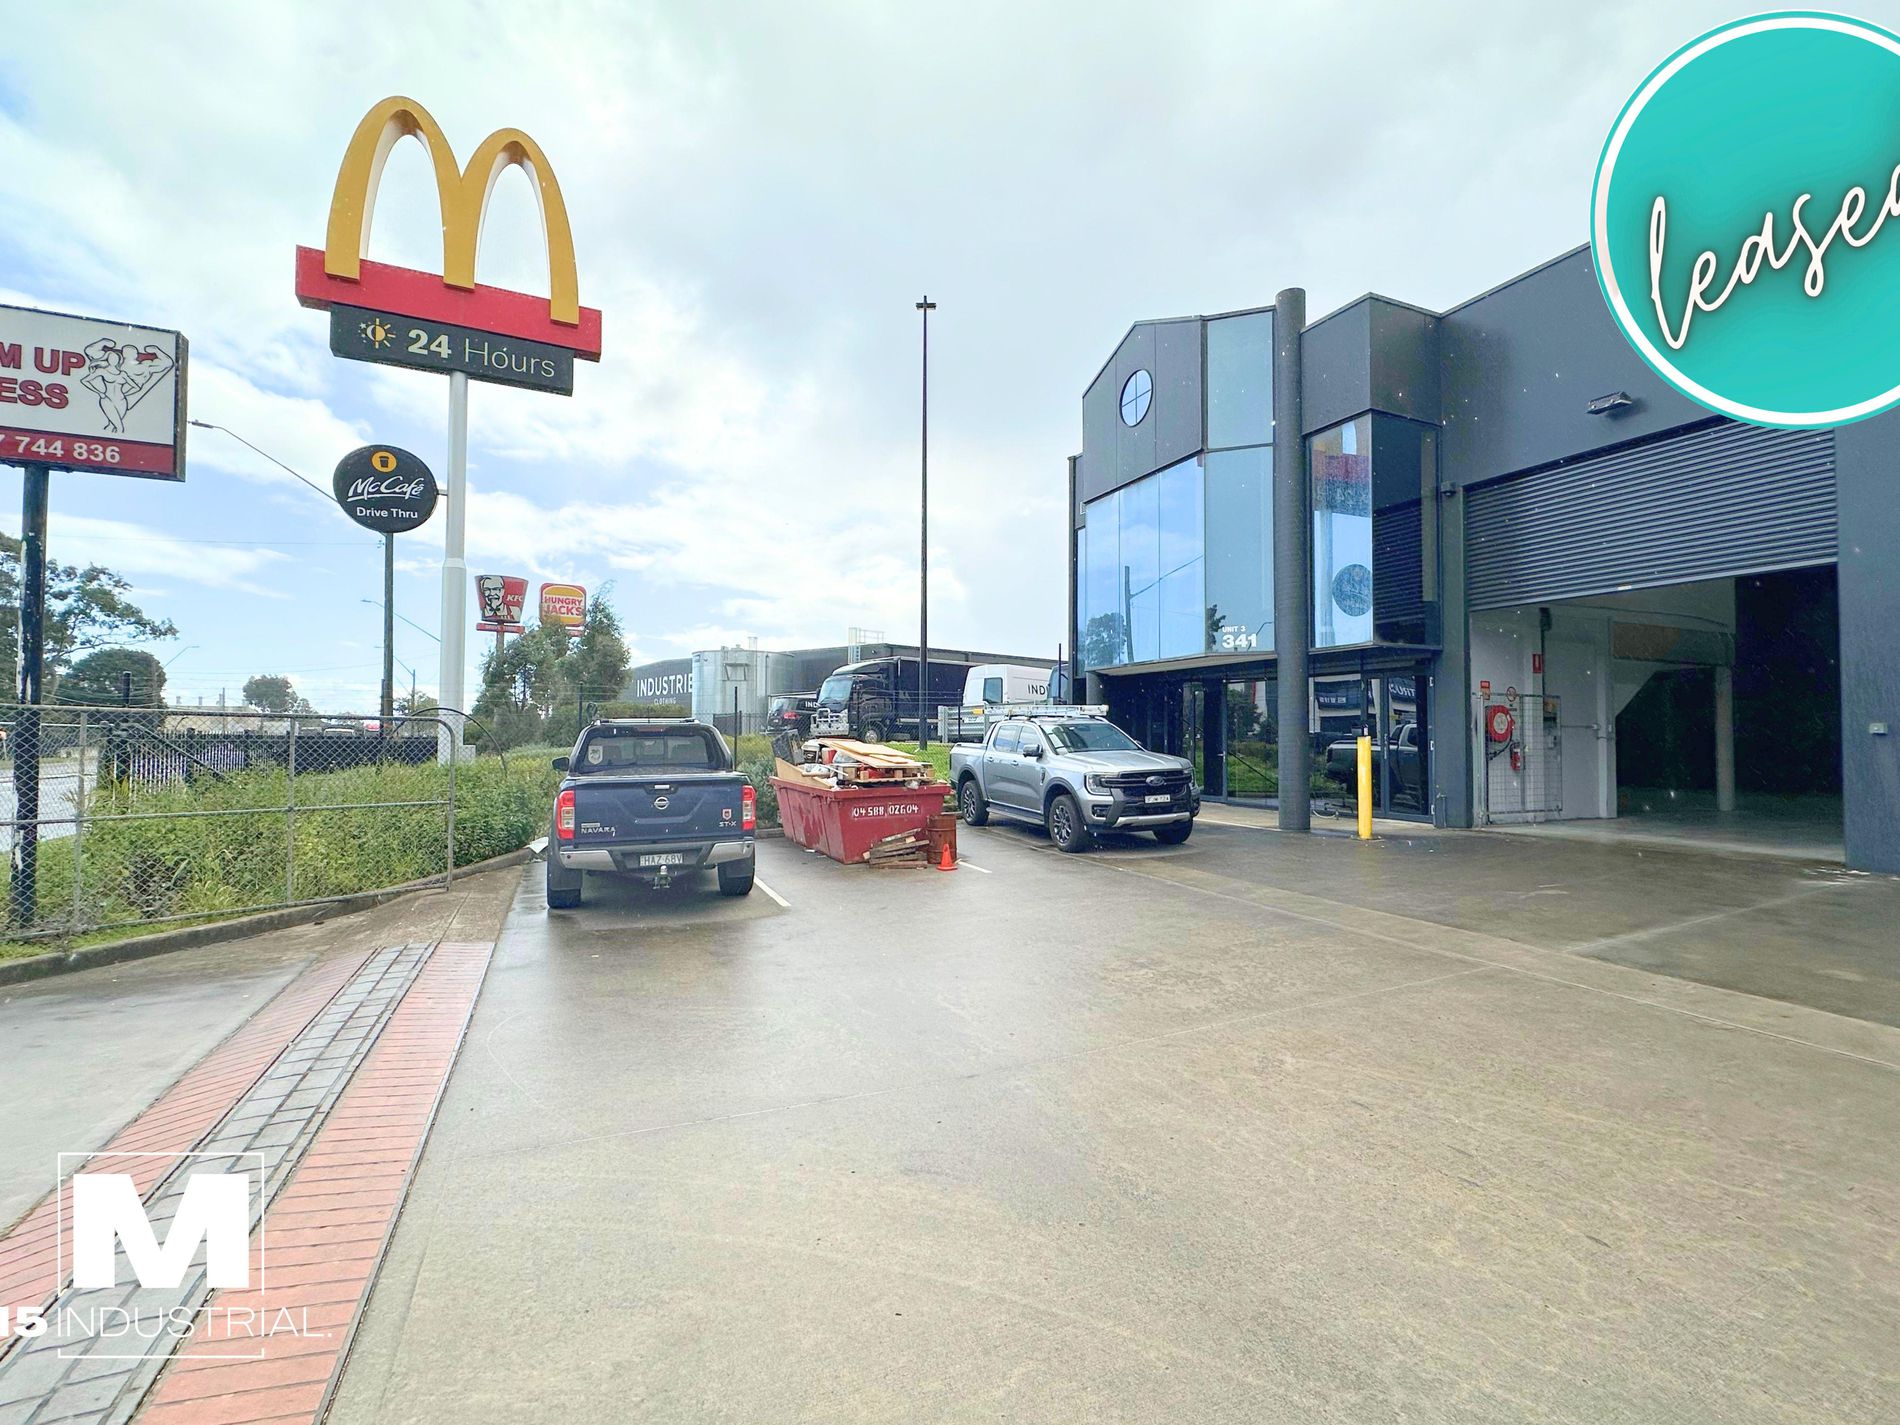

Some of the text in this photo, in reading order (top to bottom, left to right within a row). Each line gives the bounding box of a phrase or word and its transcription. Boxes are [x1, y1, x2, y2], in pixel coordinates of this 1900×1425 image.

[407, 328, 555, 378] 24 Hours
[34, 347, 86, 376] UP
[0, 377, 69, 409] ESS
[15, 435, 64, 457] 744
[73, 442, 120, 463] 836
[348, 475, 425, 500] McCafé
[356, 507, 418, 518] Drive Thru
[506, 594, 523, 602] KFC
[544, 595, 583, 606] HUNGRY
[1222, 625, 1238, 633] UNIT
[1222, 633, 1257, 649] 341
[853, 807, 866, 817] 04
[581, 826, 616, 834] NAVARA
